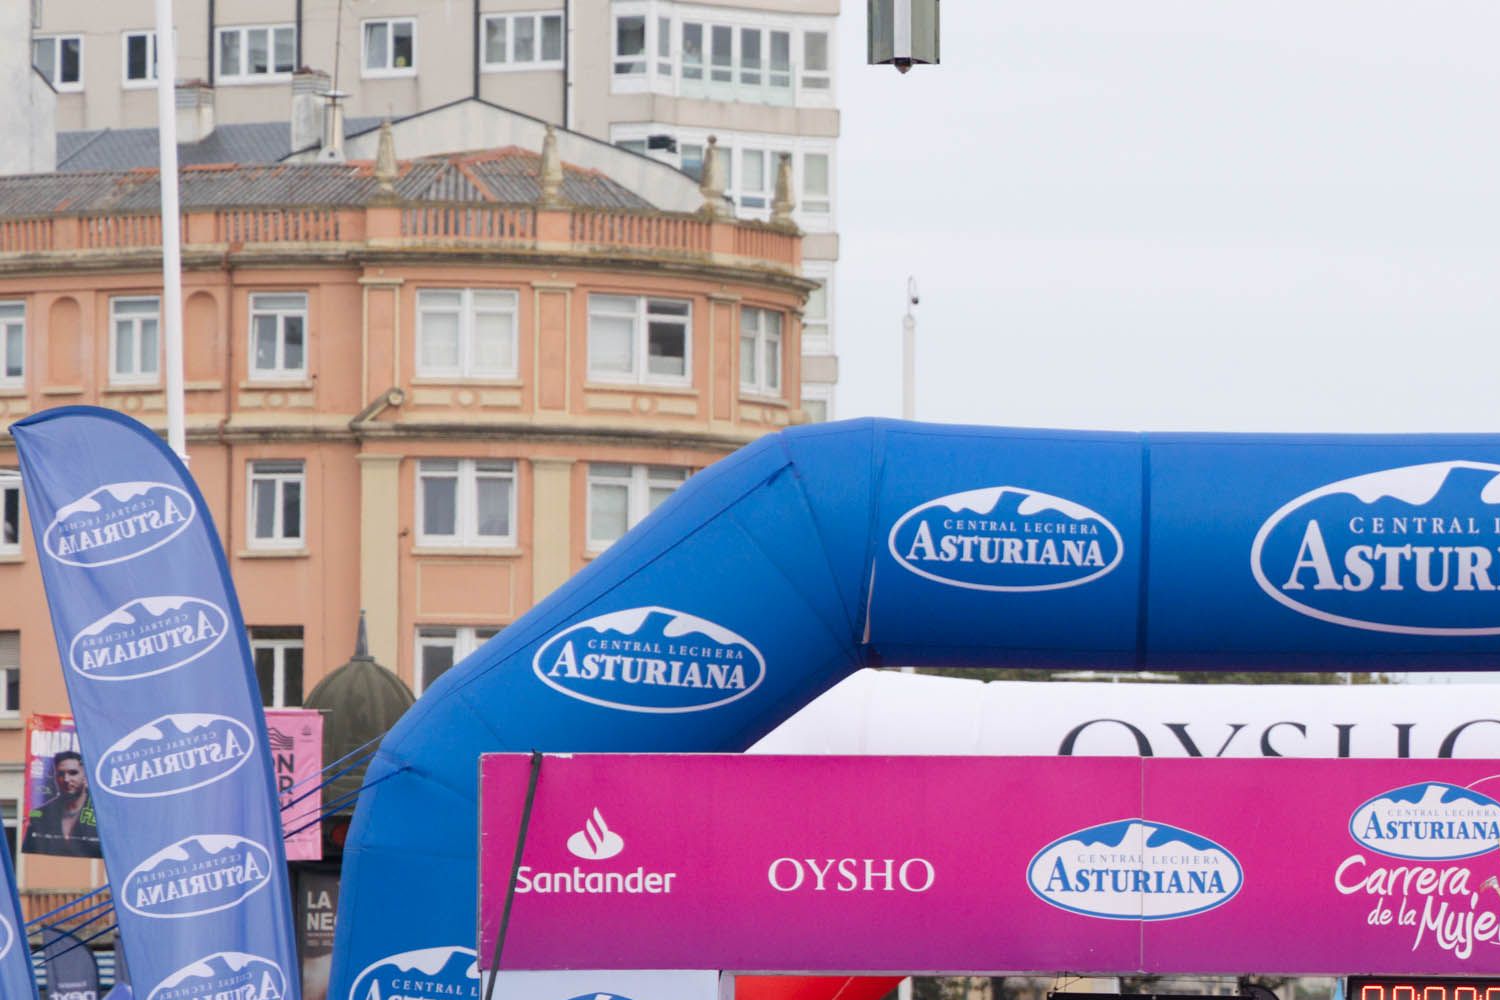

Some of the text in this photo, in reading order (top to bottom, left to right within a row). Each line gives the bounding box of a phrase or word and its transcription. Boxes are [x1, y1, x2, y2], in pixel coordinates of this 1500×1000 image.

[943, 517, 1100, 536] CENTRAL LECHERA
[1348, 515, 1481, 535] CENTRAL
[905, 519, 1105, 568] ASTURIANA
[587, 638, 744, 661] CENTRAL LECHERA
[553, 640, 747, 690] ASTURIANA
[1362, 811, 1500, 840] ASTURIANA
[1076, 853, 1220, 867] CENTRAL LECHERA
[514, 866, 676, 894] Santander
[767, 857, 935, 893] OYSHO
[1043, 854, 1227, 896] ASTURIANA
[1334, 854, 1472, 896] Carrera
[307, 891, 332, 909] LA
[1368, 898, 1393, 926] de
[1398, 898, 1417, 926] la
[306, 912, 337, 931] NE
[391, 978, 463, 996] CENTRAL
